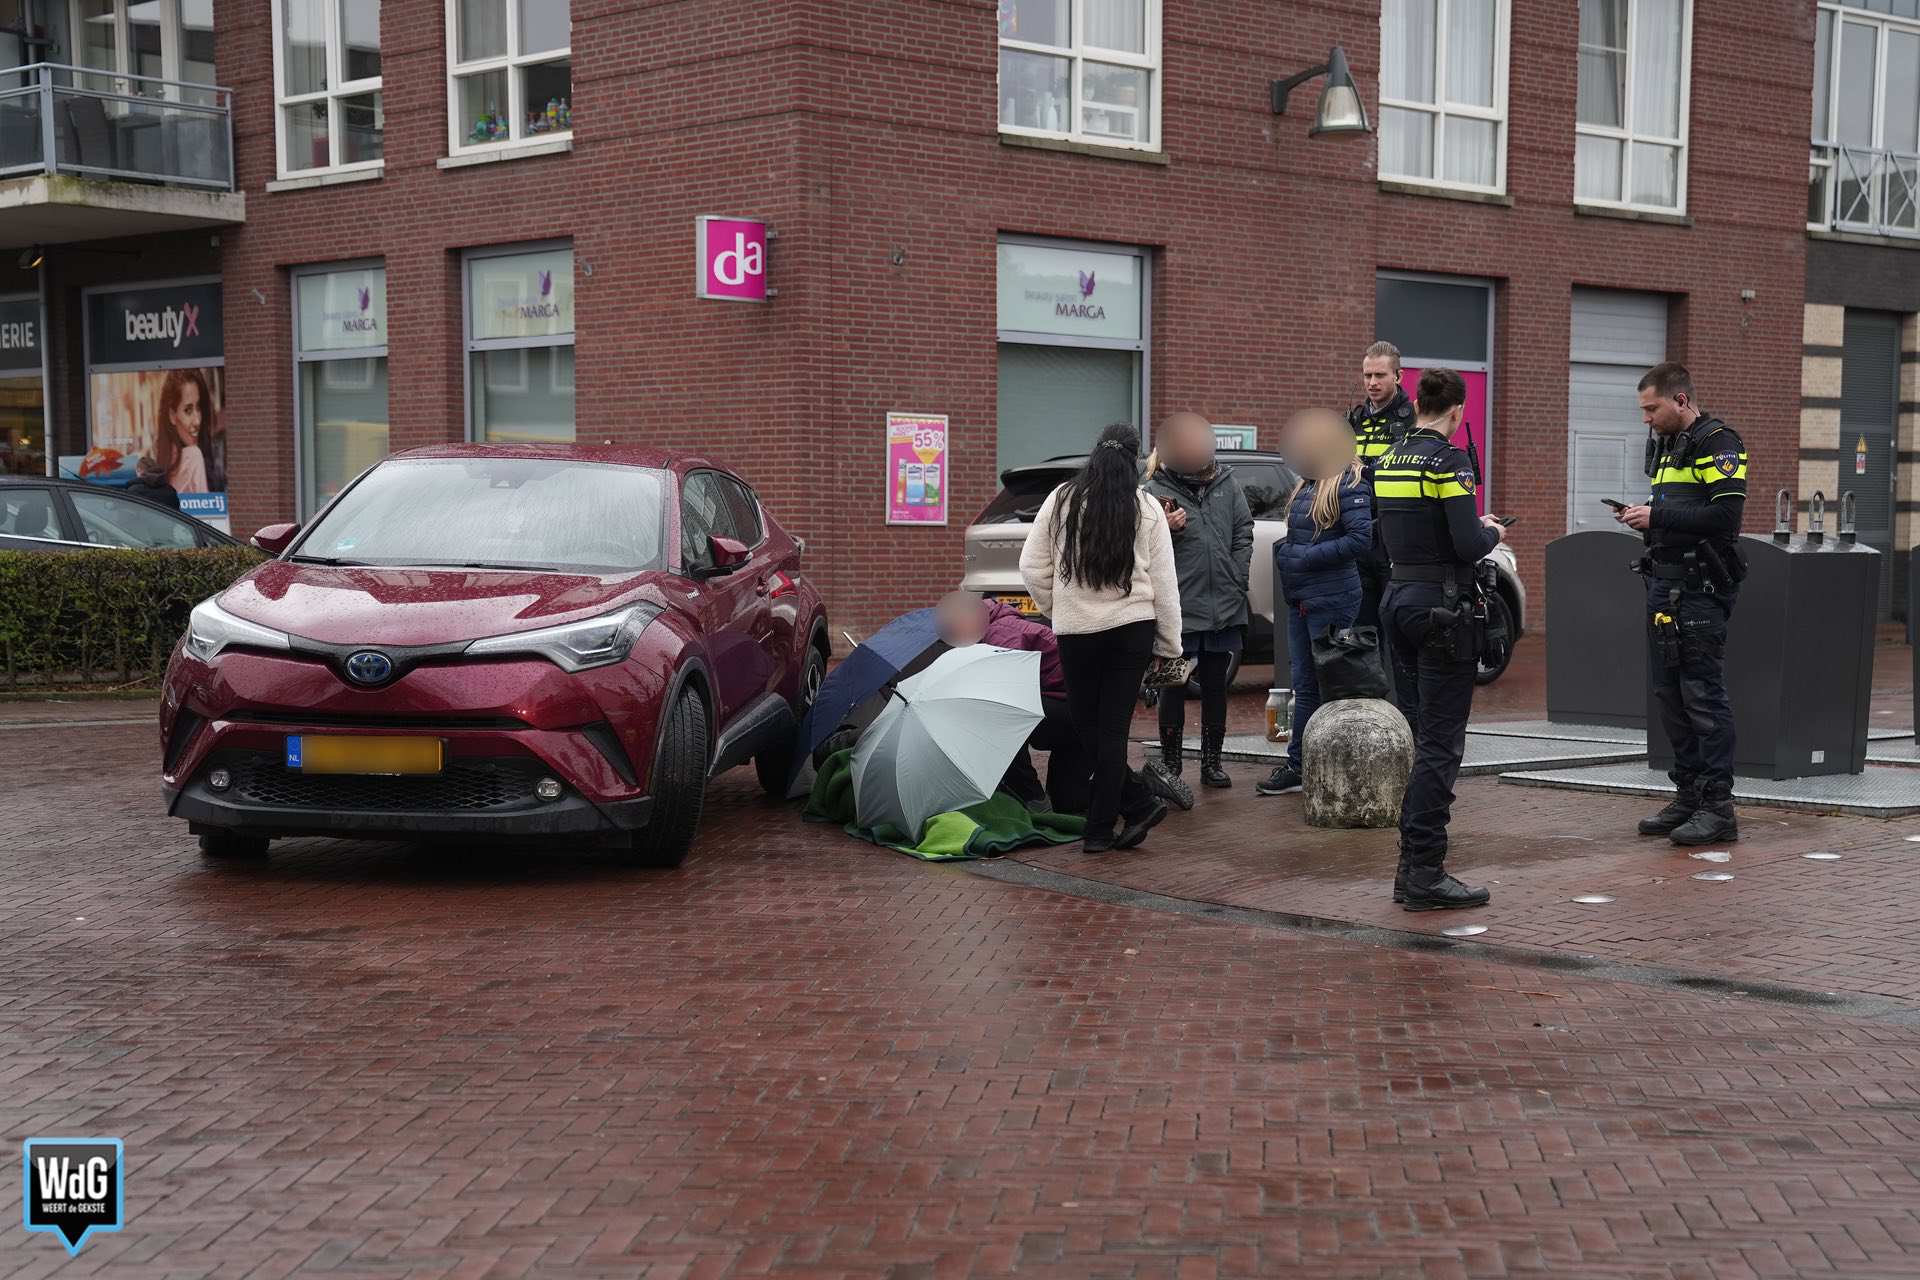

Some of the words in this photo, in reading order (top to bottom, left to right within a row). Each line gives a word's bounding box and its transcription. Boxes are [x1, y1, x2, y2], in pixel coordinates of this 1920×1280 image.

[713, 232, 762, 285] da
[519, 303, 560, 319] MARGA
[1055, 302, 1106, 319] MARGA
[341, 317, 378, 332] MARGA
[0, 321, 35, 349] ERIE
[914, 431, 944, 449] 55%
[180, 495, 225, 512] omerij
[289, 754, 299, 762] NL
